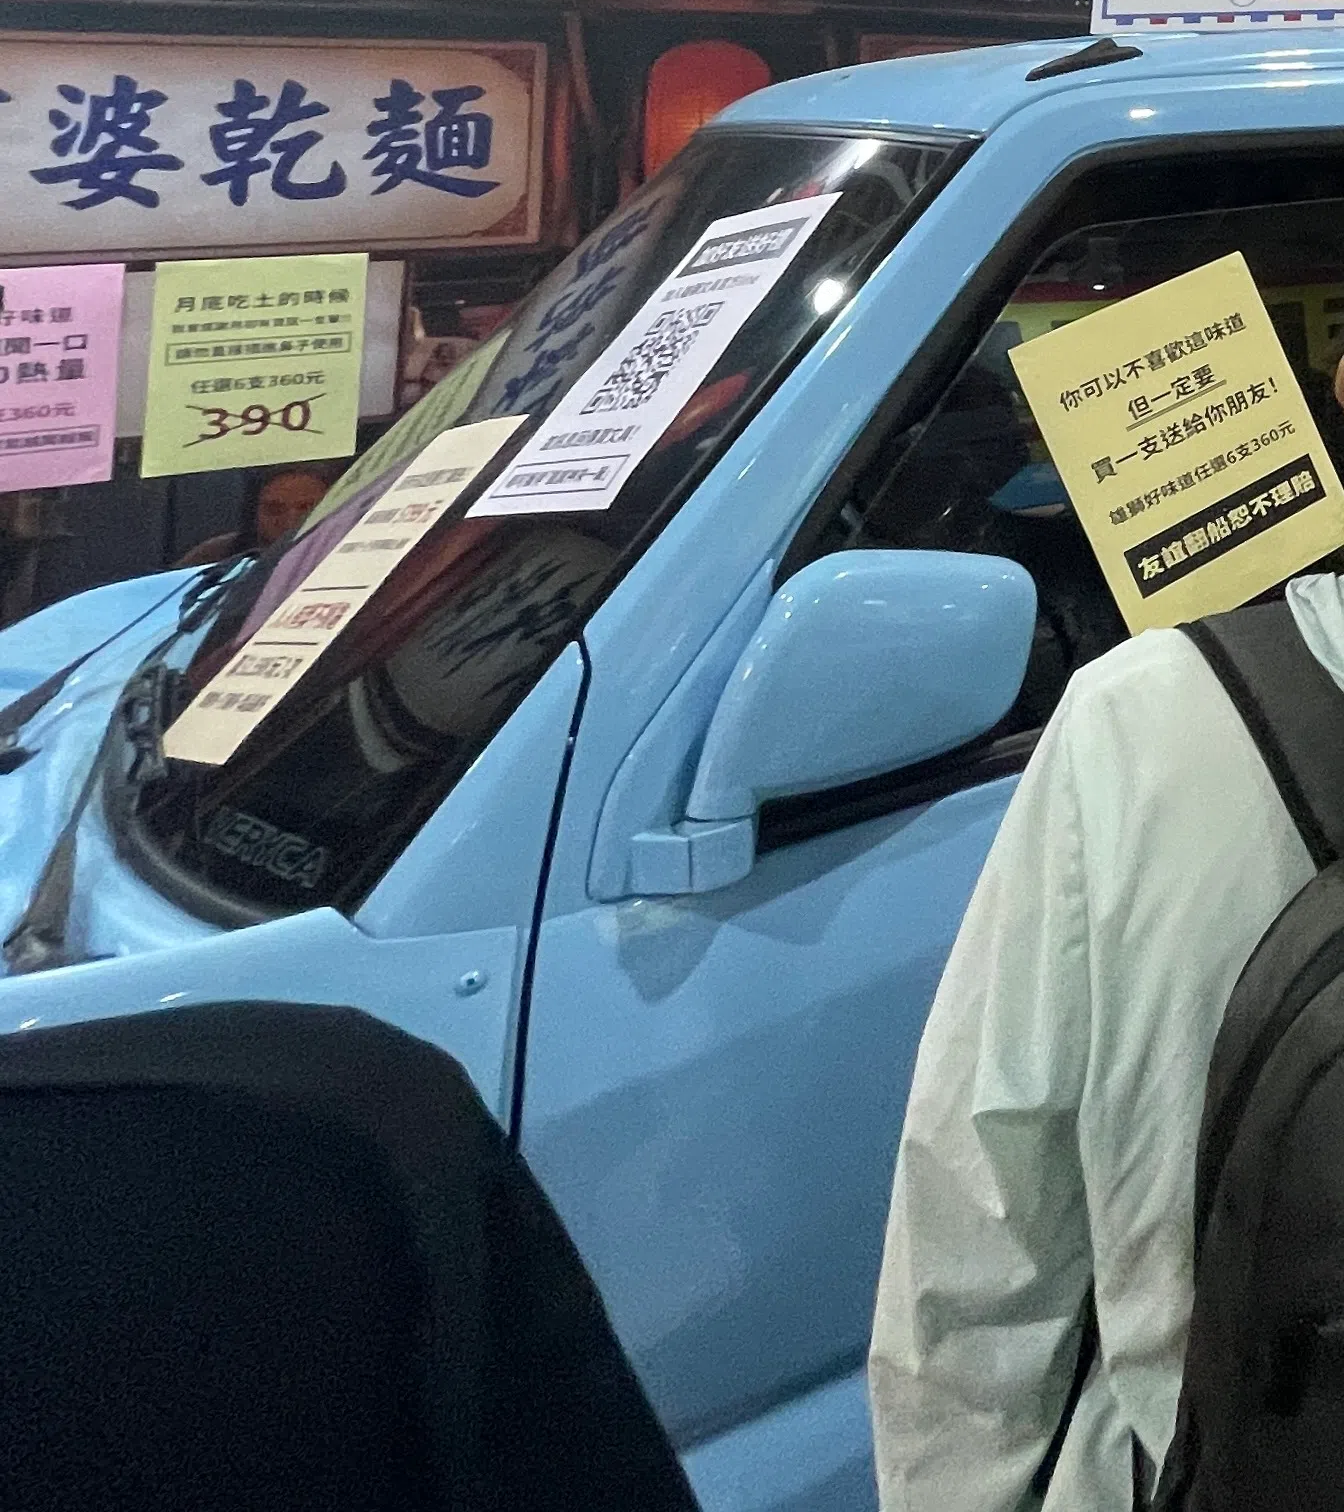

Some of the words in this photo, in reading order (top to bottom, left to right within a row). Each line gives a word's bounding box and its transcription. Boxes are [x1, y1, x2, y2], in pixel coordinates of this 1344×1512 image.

[0, 74, 502, 211] 婆乾麵
[174, 288, 350, 313] 月底吃土的時候
[190, 369, 325, 394] 任選6支360元
[1059, 312, 1247, 412] 你可以不喜歡這味道
[1127, 364, 1217, 420] 但一定要
[198, 400, 311, 441] 390
[1090, 377, 1279, 484] 買一支送給你朋友!
[1109, 420, 1296, 527] 雄獅好味道任選6支360元
[1138, 470, 1316, 581] 友誼翻船恕不理賠
